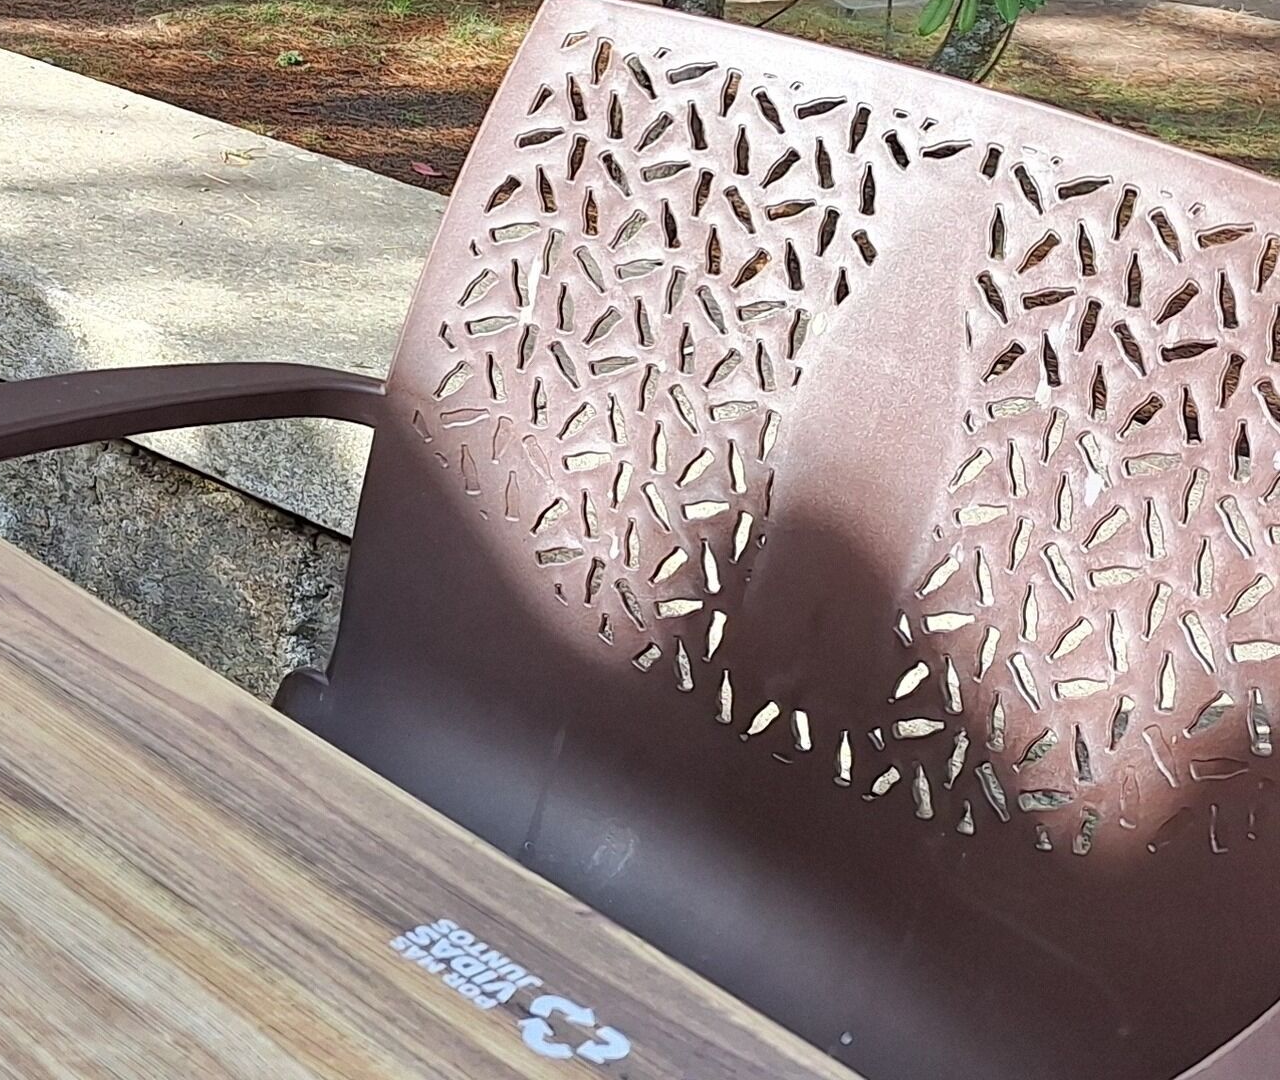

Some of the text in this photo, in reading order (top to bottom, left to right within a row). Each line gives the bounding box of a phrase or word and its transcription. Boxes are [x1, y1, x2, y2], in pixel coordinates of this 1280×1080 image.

[404, 924, 518, 1004] VIDAS
[430, 918, 545, 989] JUNTOS
[441, 972, 499, 1010] POR
